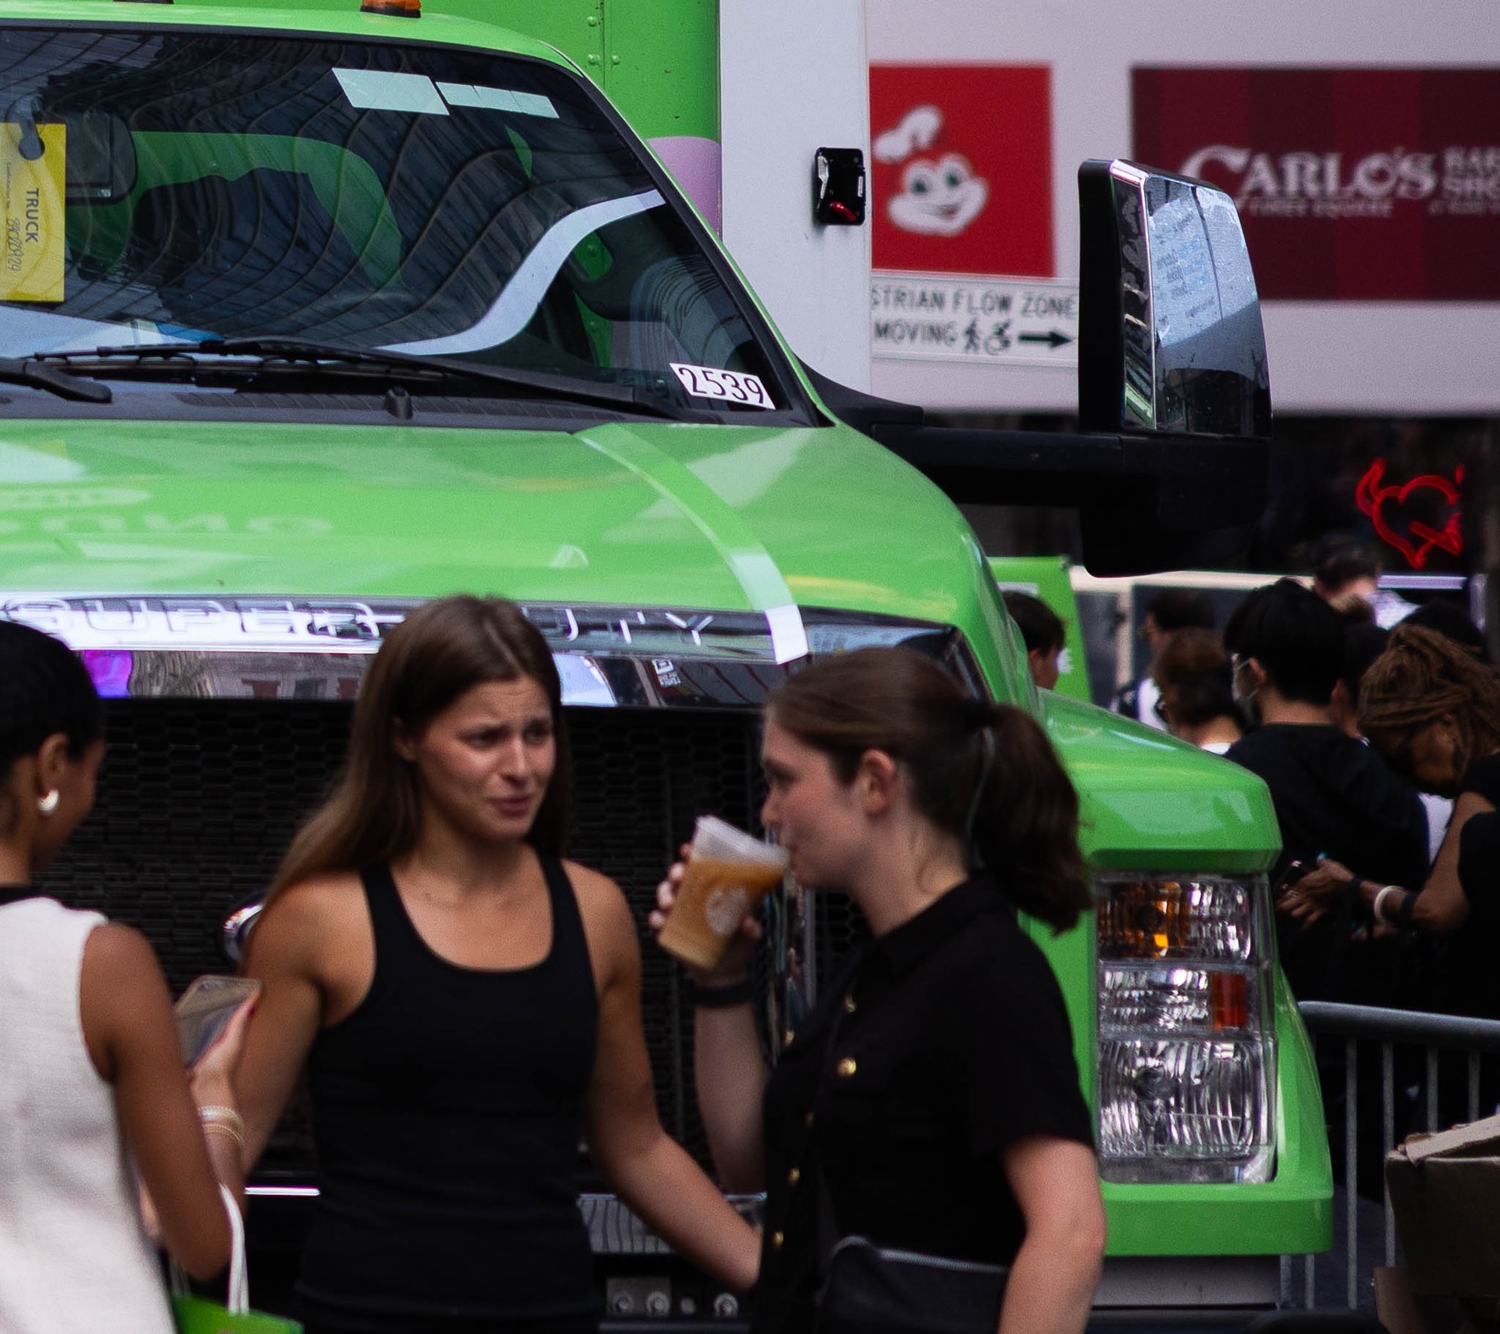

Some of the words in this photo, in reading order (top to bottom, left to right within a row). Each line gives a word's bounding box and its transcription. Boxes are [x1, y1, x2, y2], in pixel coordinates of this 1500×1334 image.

[1180, 145, 1438, 210] CARLO'S
[25, 187, 40, 243] TRUCK
[871, 285, 945, 310] STRIAN
[952, 288, 1013, 316] FLOW
[1020, 291, 1077, 320] ZONE
[874, 320, 957, 346] MOVING
[678, 367, 764, 404] 2539
[3, 595, 392, 639] SUPER
